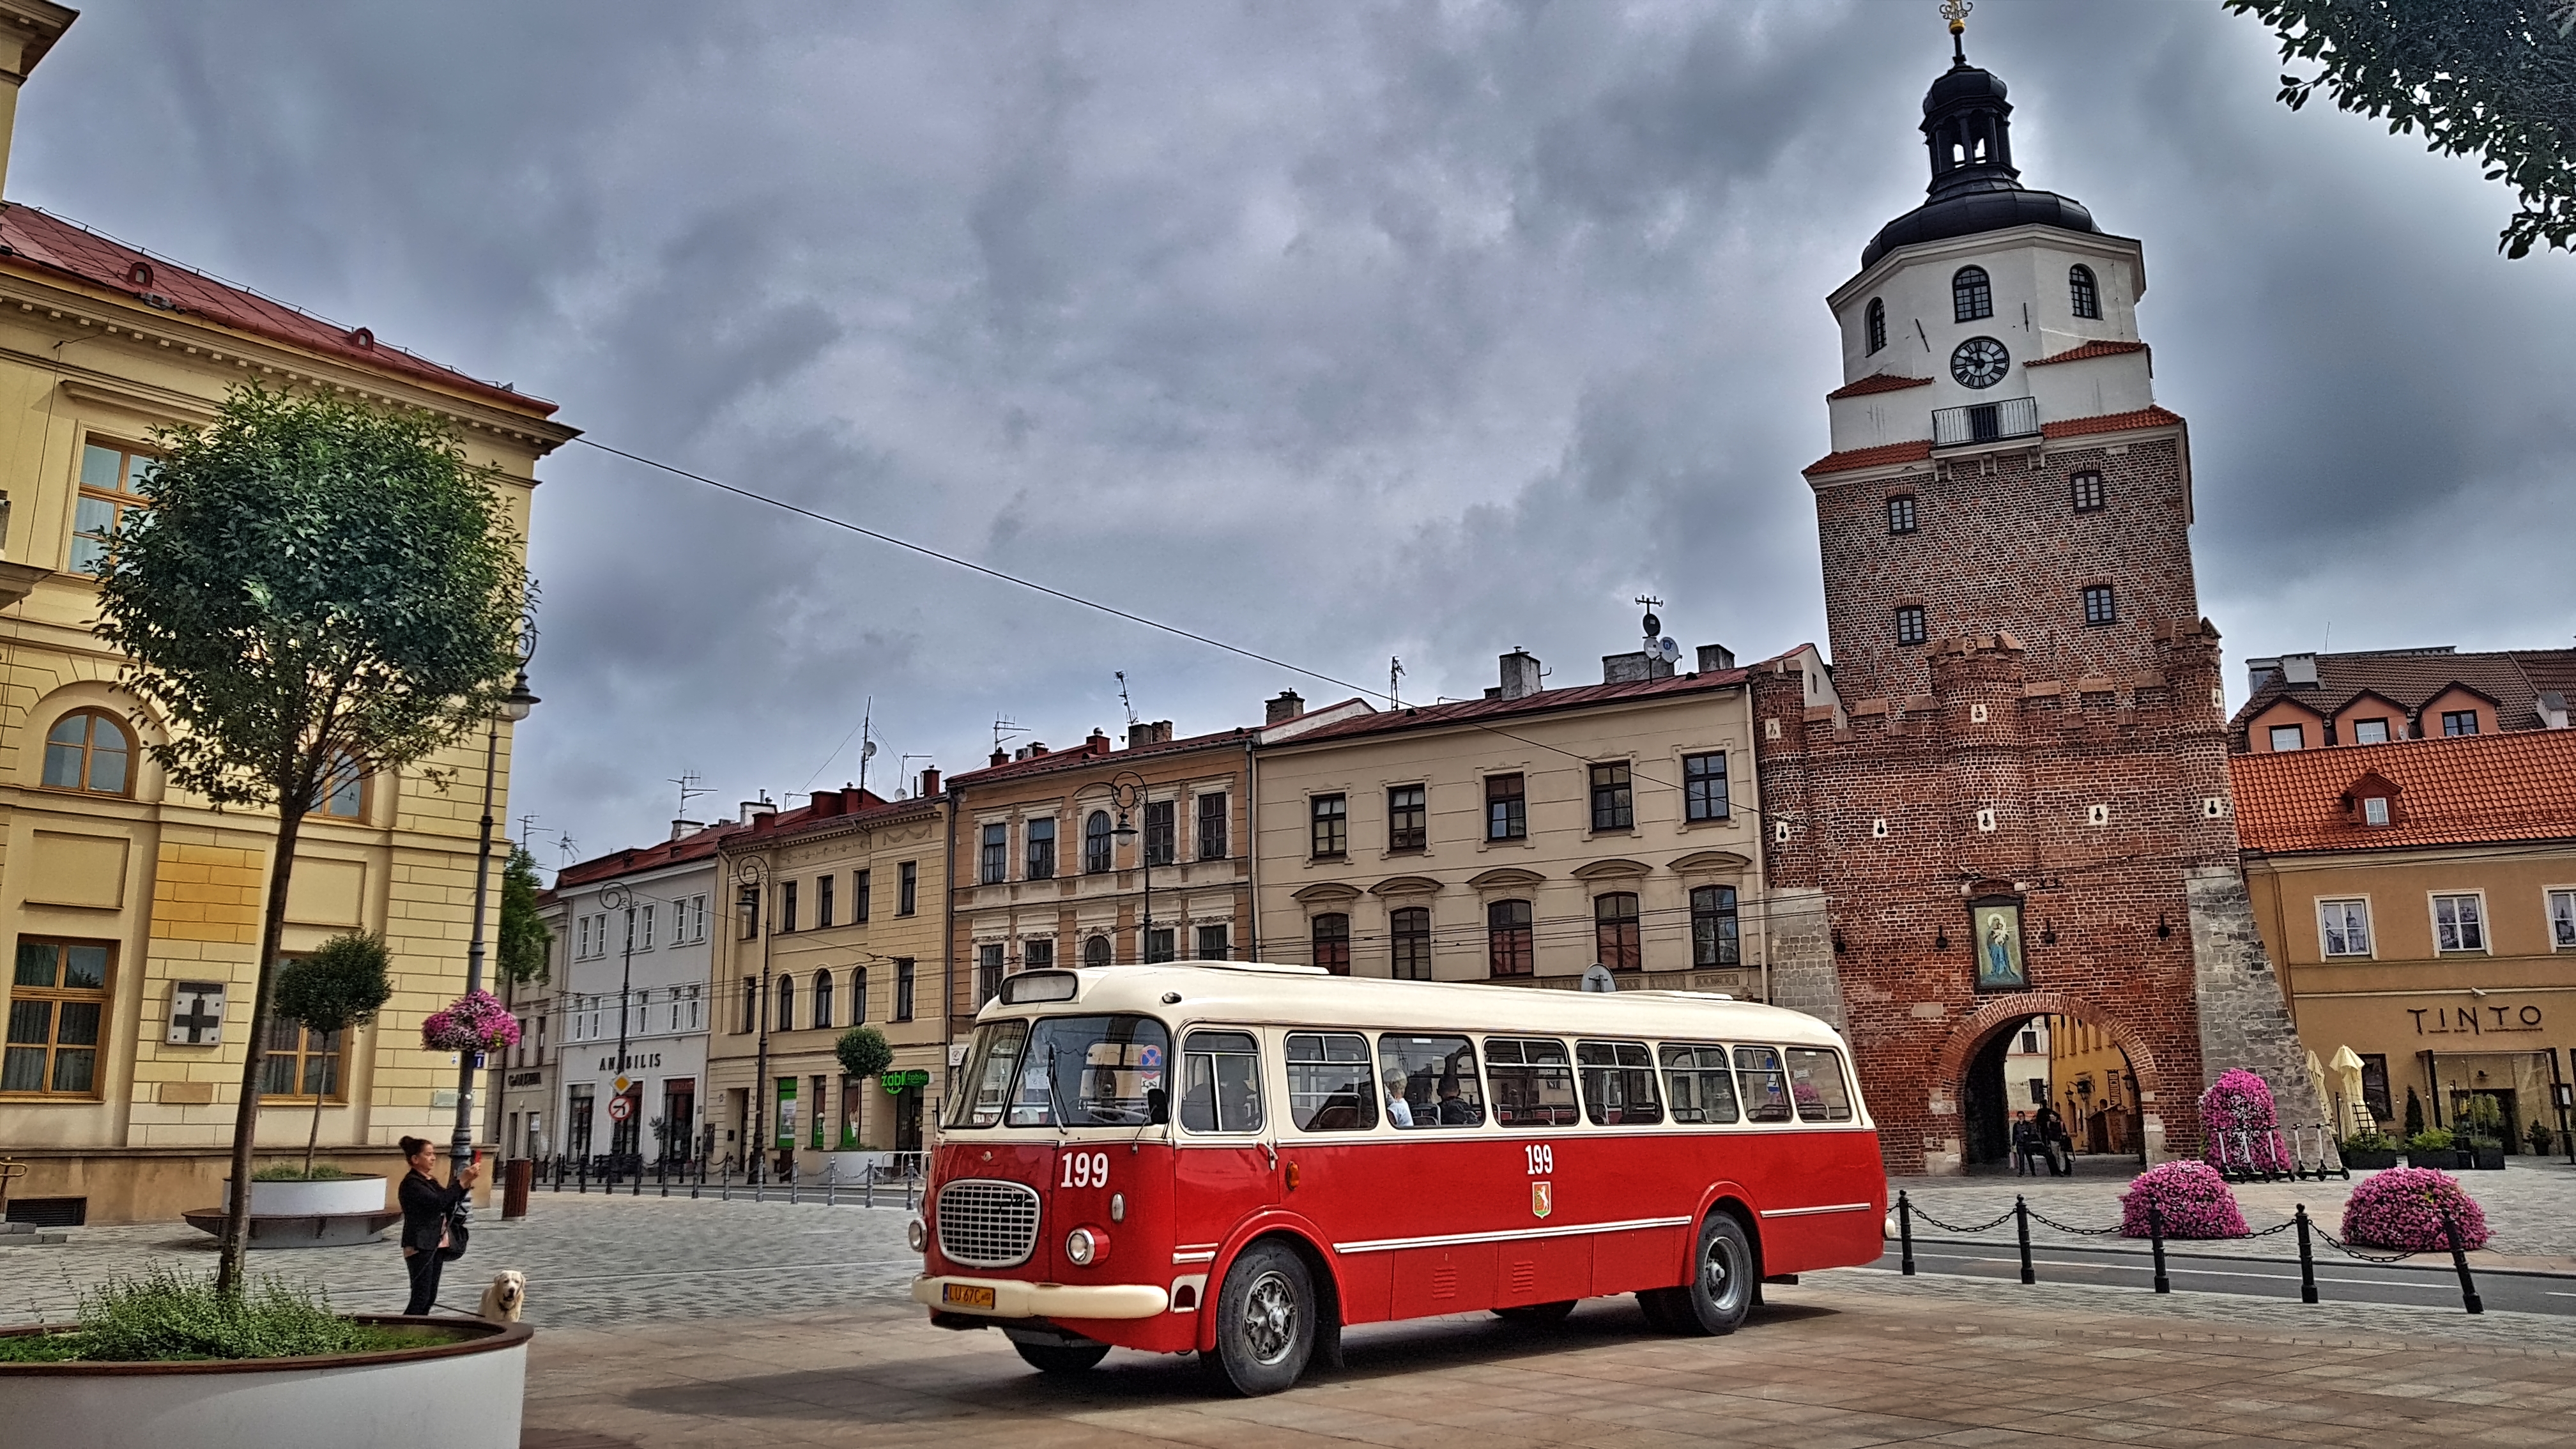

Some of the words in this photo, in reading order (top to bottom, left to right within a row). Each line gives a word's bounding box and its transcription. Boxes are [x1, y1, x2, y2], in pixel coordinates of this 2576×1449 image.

[2407, 1006, 2542, 1035] TINTO
[477, 1057, 482, 1067] 1
[1061, 1152, 1108, 1188] 199
[1525, 1144, 1553, 1175] 199
[949, 1287, 962, 1301] LU
[963, 1288, 981, 1303] 67C
